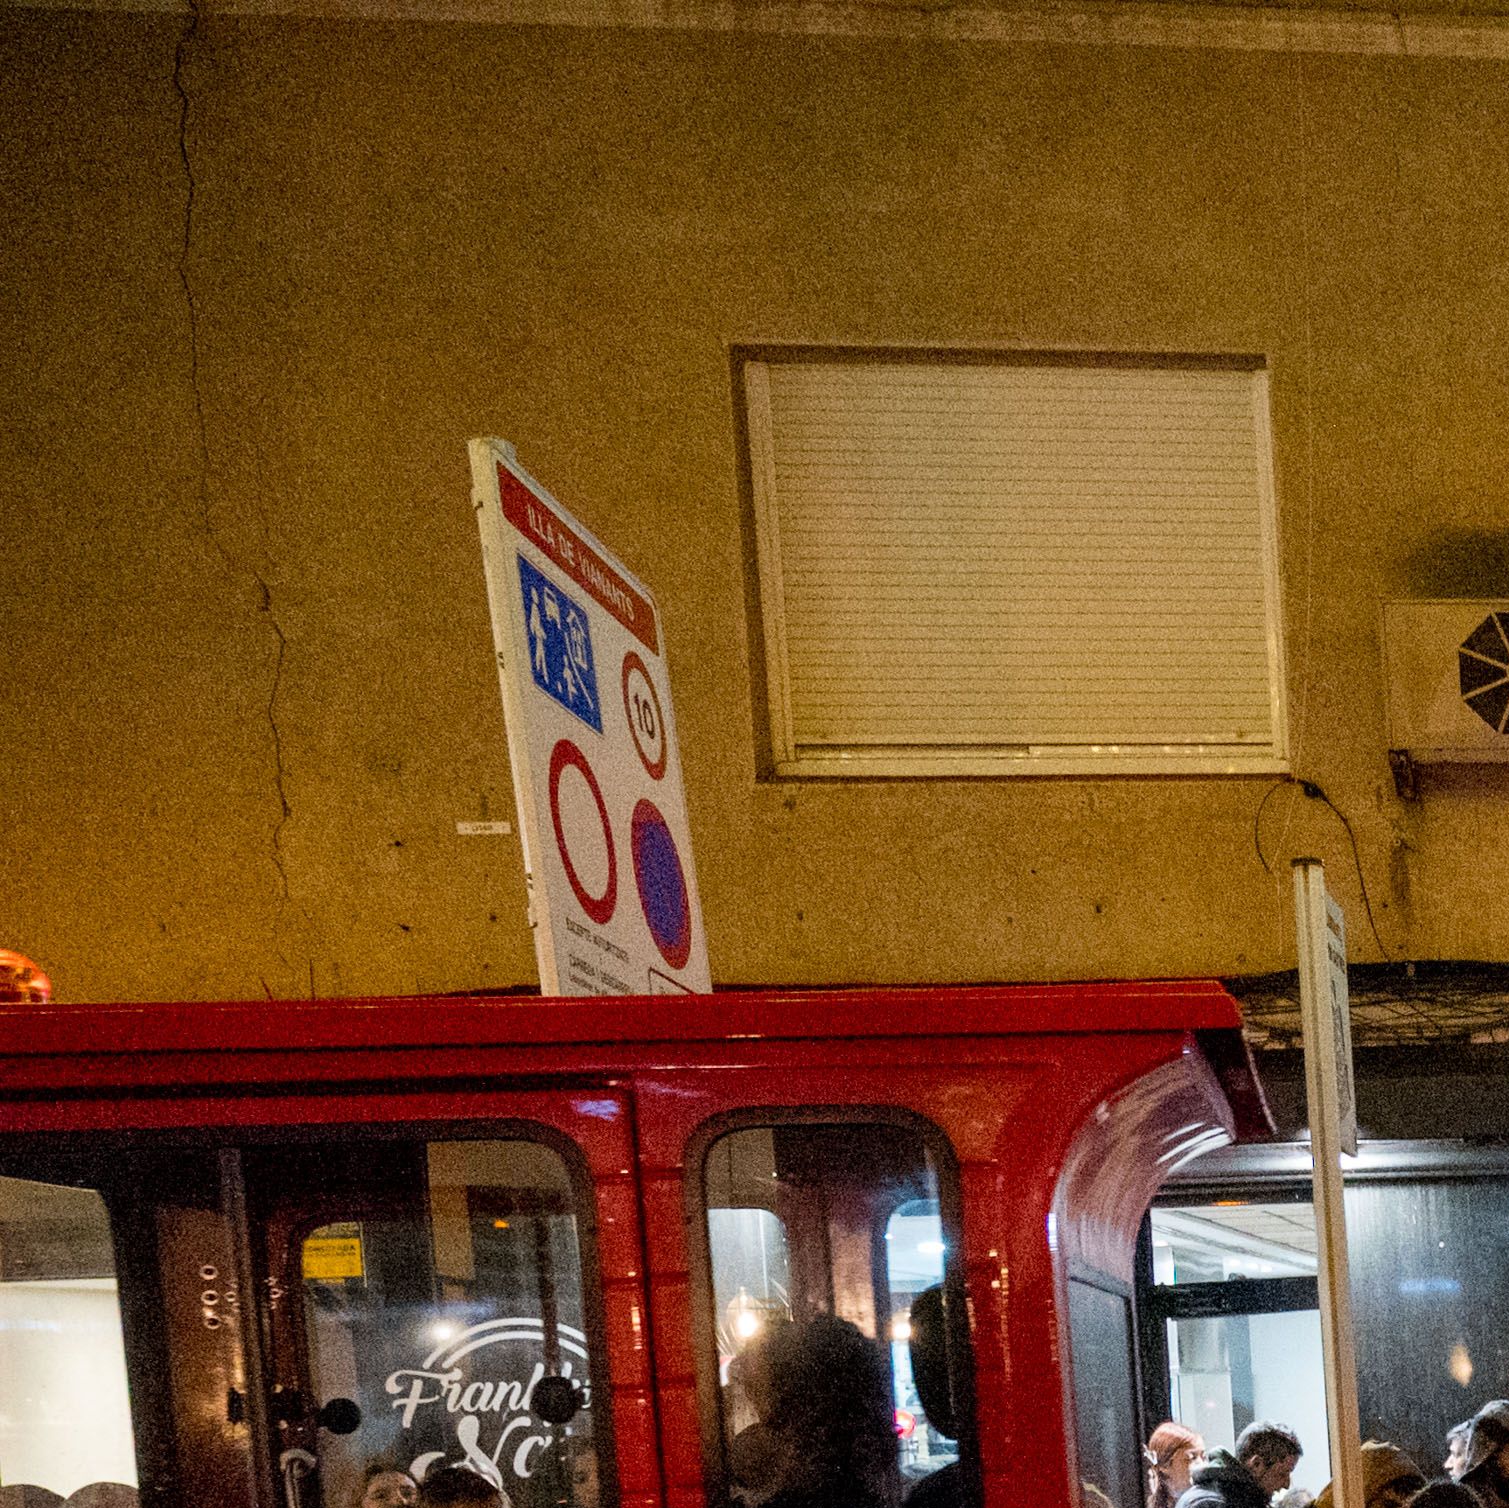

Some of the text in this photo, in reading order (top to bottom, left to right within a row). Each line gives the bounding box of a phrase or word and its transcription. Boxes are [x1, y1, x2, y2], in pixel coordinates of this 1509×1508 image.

[526, 502, 556, 550] ILLA
[557, 532, 576, 569] DE
[632, 692, 655, 741] 10
